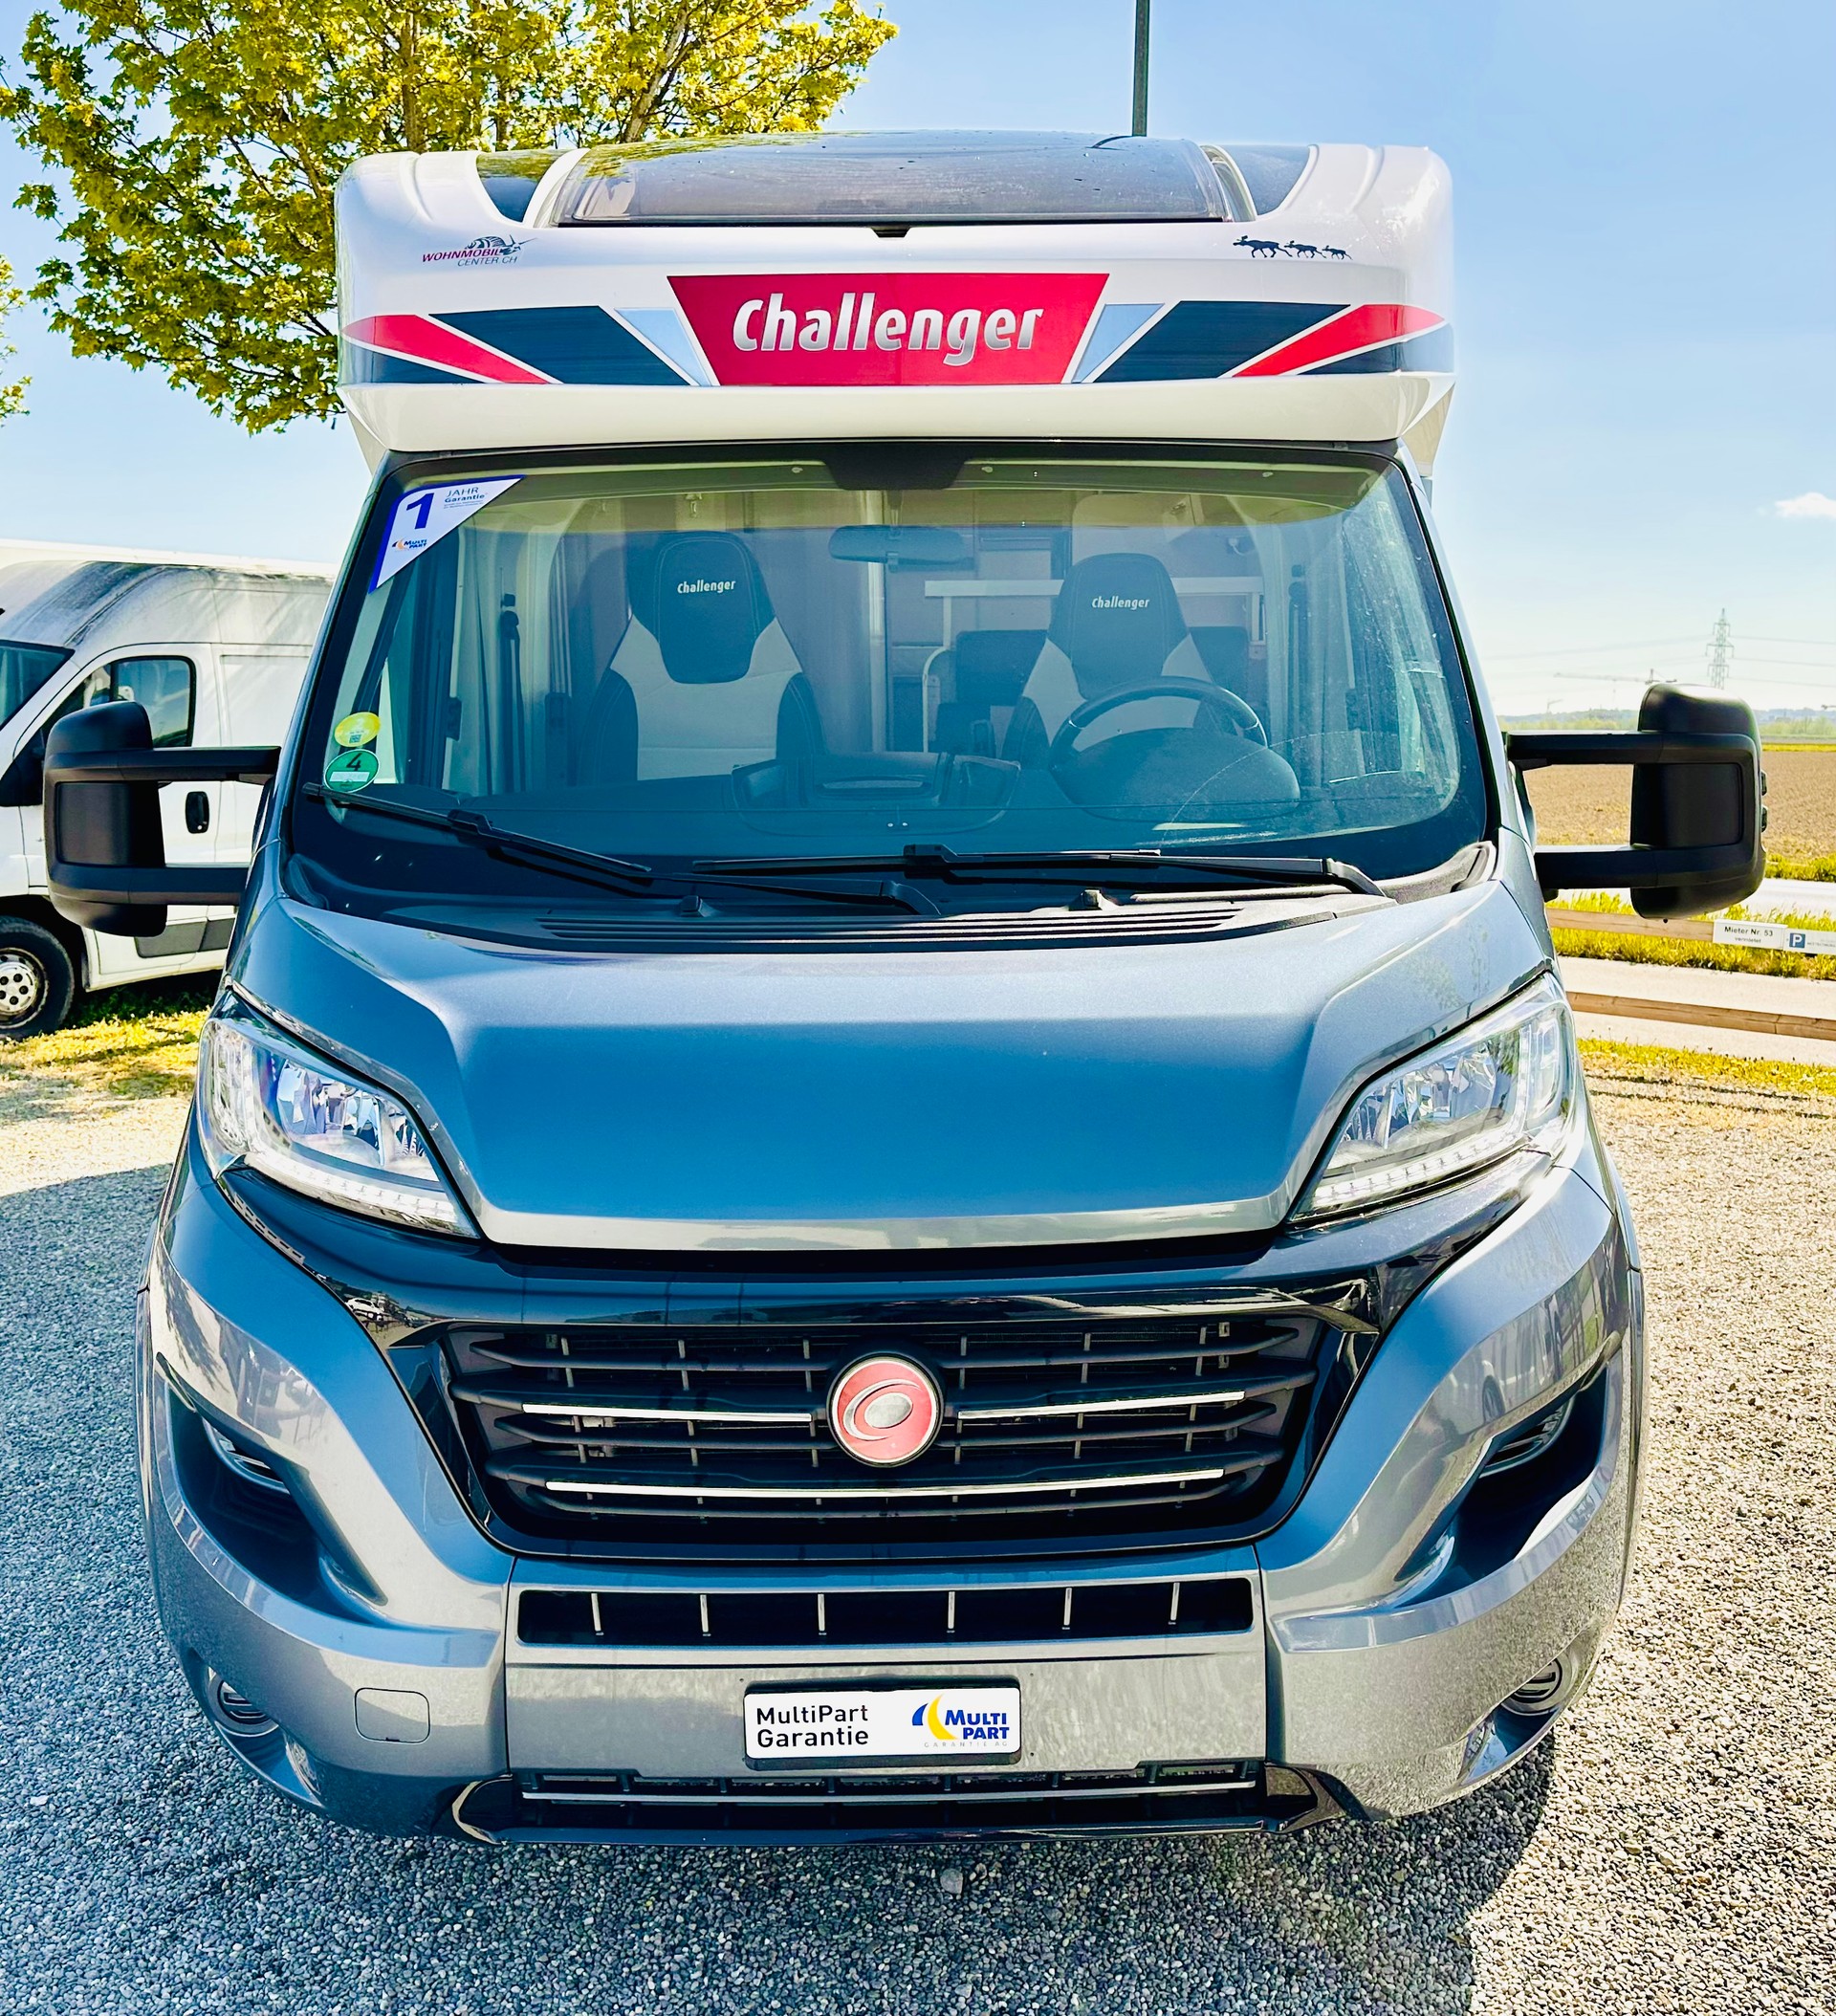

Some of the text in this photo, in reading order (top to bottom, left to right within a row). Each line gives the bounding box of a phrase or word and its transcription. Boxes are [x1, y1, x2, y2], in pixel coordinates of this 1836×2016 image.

[422, 248, 502, 262] WOHNMOBIL
[732, 293, 1044, 366] Challenger
[445, 493, 485, 503] Garantie
[447, 487, 479, 497] JAHR
[406, 493, 435, 530] 1
[677, 579, 736, 594] Challenger
[1091, 595, 1150, 611] Challenger
[346, 753, 363, 772] 4
[1724, 926, 1748, 934] Mieter
[1792, 933, 1803, 947] P
[756, 1704, 868, 1725] MultiPart
[944, 1710, 1007, 1725] MULTI
[757, 1725, 869, 1748] Garantie
[962, 1727, 1010, 1740] PART
